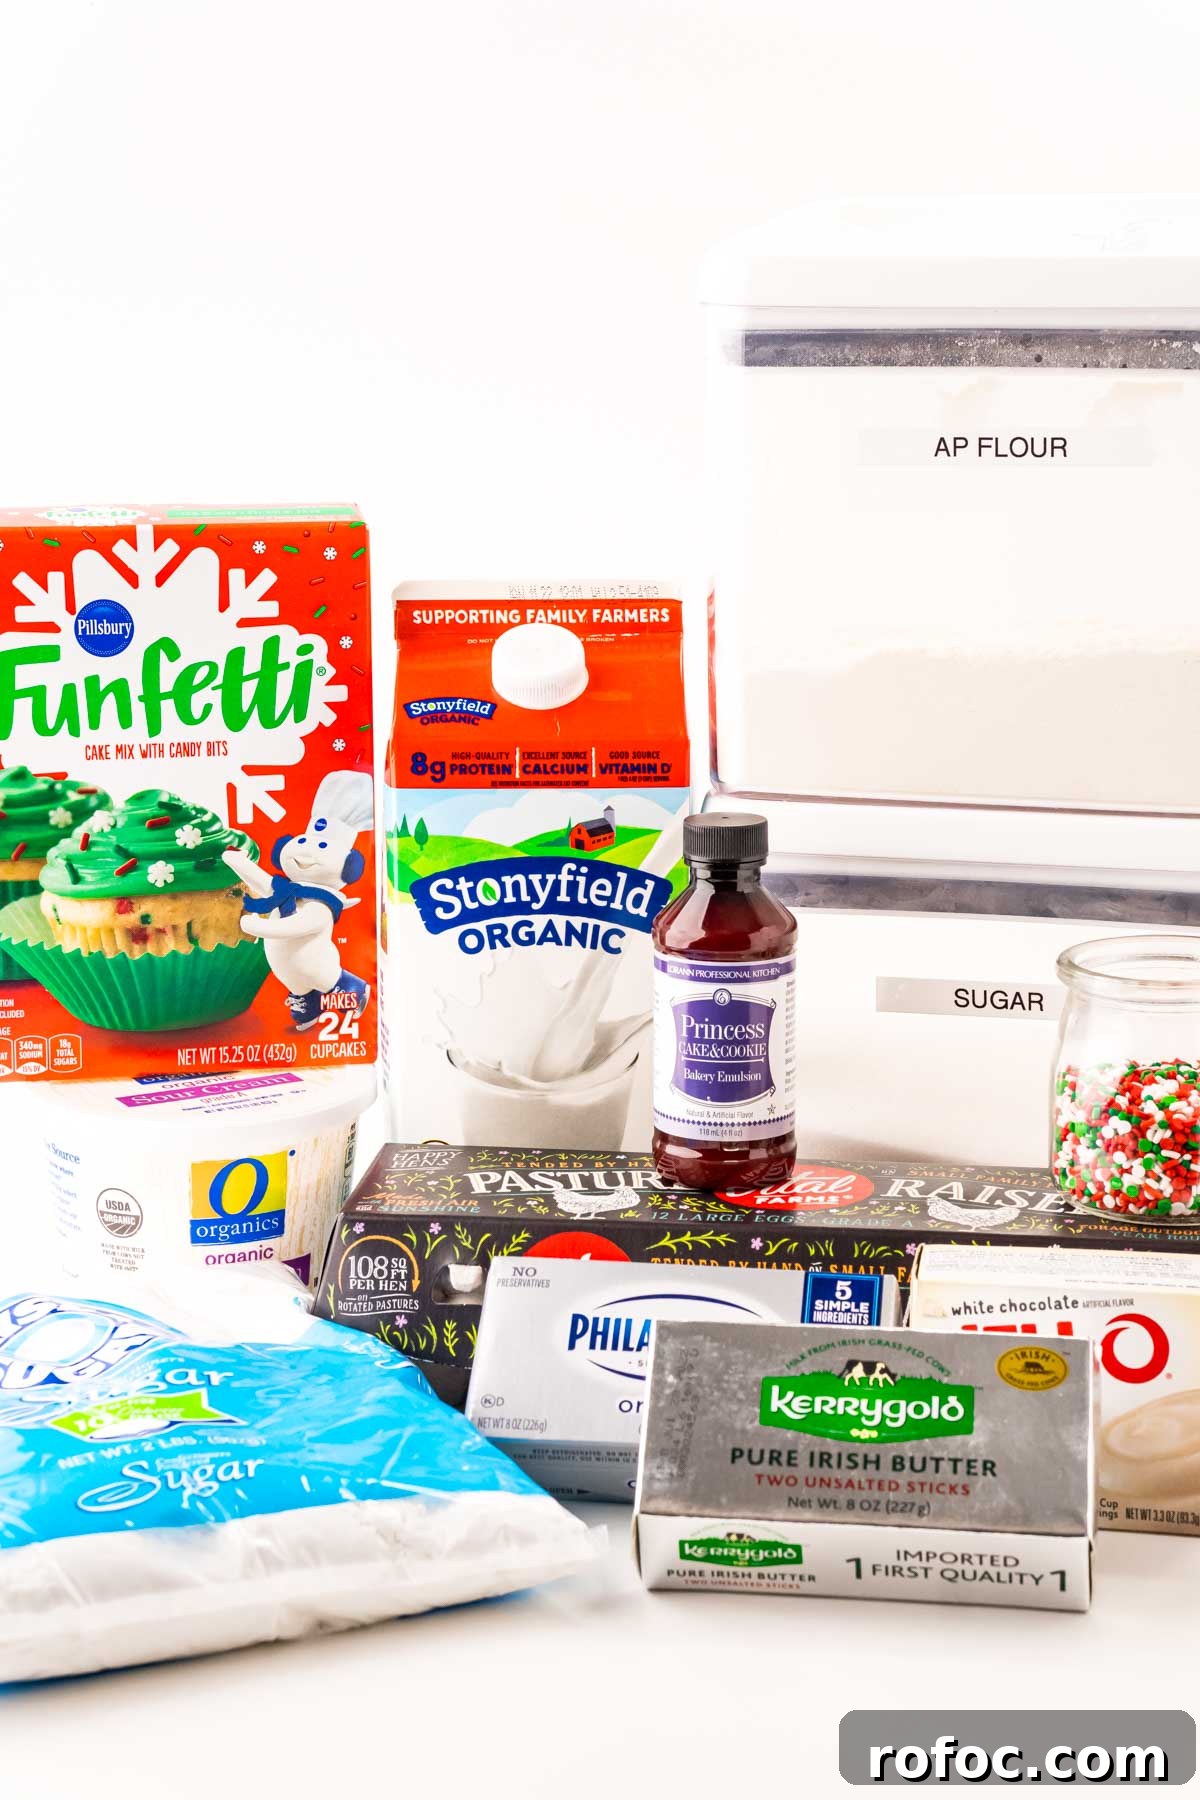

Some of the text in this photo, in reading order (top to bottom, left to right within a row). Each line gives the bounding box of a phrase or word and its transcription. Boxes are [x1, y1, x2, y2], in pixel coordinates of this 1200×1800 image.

[934, 436, 1068, 458] AP FLOUR
[412, 608, 670, 625] SUPPORTING FAMILY FARMERS
[77, 619, 133, 638] Pillsbury
[0, 635, 314, 740] Funfetti
[410, 698, 491, 715] Stonyfield
[420, 714, 480, 726] ORGANIC
[85, 740, 228, 761] CAKE MIX WITH CANDY BITS
[523, 752, 587, 760] EXCELLENT SOURCE
[609, 751, 660, 759] GOOD SOURCE
[411, 752, 446, 783] 8g
[523, 763, 588, 774] CALCIUM
[599, 763, 657, 774] VITAMIN
[429, 863, 655, 920] Stonyfield
[458, 919, 626, 955] ORGANIC
[695, 969, 751, 979] PROFESSIONAL
[753, 967, 780, 977] KITCHEN
[320, 993, 358, 1010] MAKES
[954, 988, 1044, 1012] SUGAR
[318, 1011, 359, 1041] 24
[681, 1014, 765, 1040] Princess
[19, 1050, 43, 1059] SODIUM
[56, 1049, 74, 1057] TOTAL
[177, 1043, 297, 1066] NET WT 15.25 OZ (432g)
[310, 1042, 366, 1059] CUPCAKES
[678, 1042, 767, 1059] CAKE&COOKIE
[53, 1057, 78, 1066] SUGARS
[684, 1068, 762, 1084] Bakery Emulsion
[131, 1088, 196, 1105] Sour
[202, 1076, 289, 1095] Cream
[51, 1143, 80, 1164] Source
[392, 1151, 464, 1161] HAPPY
[391, 1159, 451, 1169] HENS
[464, 1170, 697, 1194] PASTUR
[906, 1170, 969, 1179] SMALL
[976, 1175, 1043, 1187] FAMILY
[208, 1157, 269, 1218] O
[756, 1196, 840, 1206] FARMS
[880, 1178, 1088, 1214] RAISE
[105, 1199, 131, 1212] USDA
[377, 1205, 481, 1214] SUNSHINE
[103, 1213, 136, 1225] ORGANIC
[651, 1212, 668, 1220] 12
[679, 1214, 745, 1222] LARGE
[754, 1214, 806, 1224] EGGS
[196, 1214, 279, 1242] organics
[1080, 1224, 1200, 1236] FORAGE OUTDOO
[348, 1255, 388, 1279] 108
[391, 1258, 407, 1268] SQ
[391, 1269, 407, 1279] FT
[512, 1266, 536, 1277] NO
[349, 1279, 406, 1291] PER HEN
[497, 1278, 550, 1288] PRESERVATIVES
[835, 1280, 852, 1300] 5
[338, 1299, 419, 1312] ROTATED PASTURES
[814, 1300, 869, 1313] SIMPLE
[952, 1295, 1079, 1316] white chocolate
[1082, 1298, 1135, 1308] ARTIFICIAL FLAVOR
[813, 1311, 868, 1325] INGREDIENTS
[567, 1313, 652, 1352] PHILA
[838, 1338, 865, 1347] IRISH
[1015, 1351, 1051, 1362] IRISH
[478, 1417, 547, 1433] NET WT 8 OZ (226g)
[57, 1452, 95, 1470] NET
[141, 1441, 154, 1452] 2
[731, 1447, 997, 1477] PURE IRISH BUTTER
[77, 1459, 265, 1513] Sugar
[755, 1474, 970, 1496] TWO UNSALTED STICKS
[787, 1496, 812, 1509] Net
[817, 1497, 841, 1511] Wt.
[846, 1499, 855, 1511] 8
[860, 1500, 881, 1512] OZ
[1099, 1498, 1118, 1509] Cup
[1125, 1508, 1138, 1520] NET
[1140, 1509, 1151, 1520] WT
[1153, 1509, 1164, 1522] 3.3
[1166, 1511, 1176, 1523] OZ
[896, 1549, 1020, 1568] IMPORTED
[667, 1569, 816, 1583] PURE IRISH BUTTER
[845, 1557, 862, 1580] 1
[872, 1564, 1044, 1586] FIRST QUALITY
[711, 1580, 763, 1588] UNSALTED
[1050, 1570, 1067, 1592] 1
